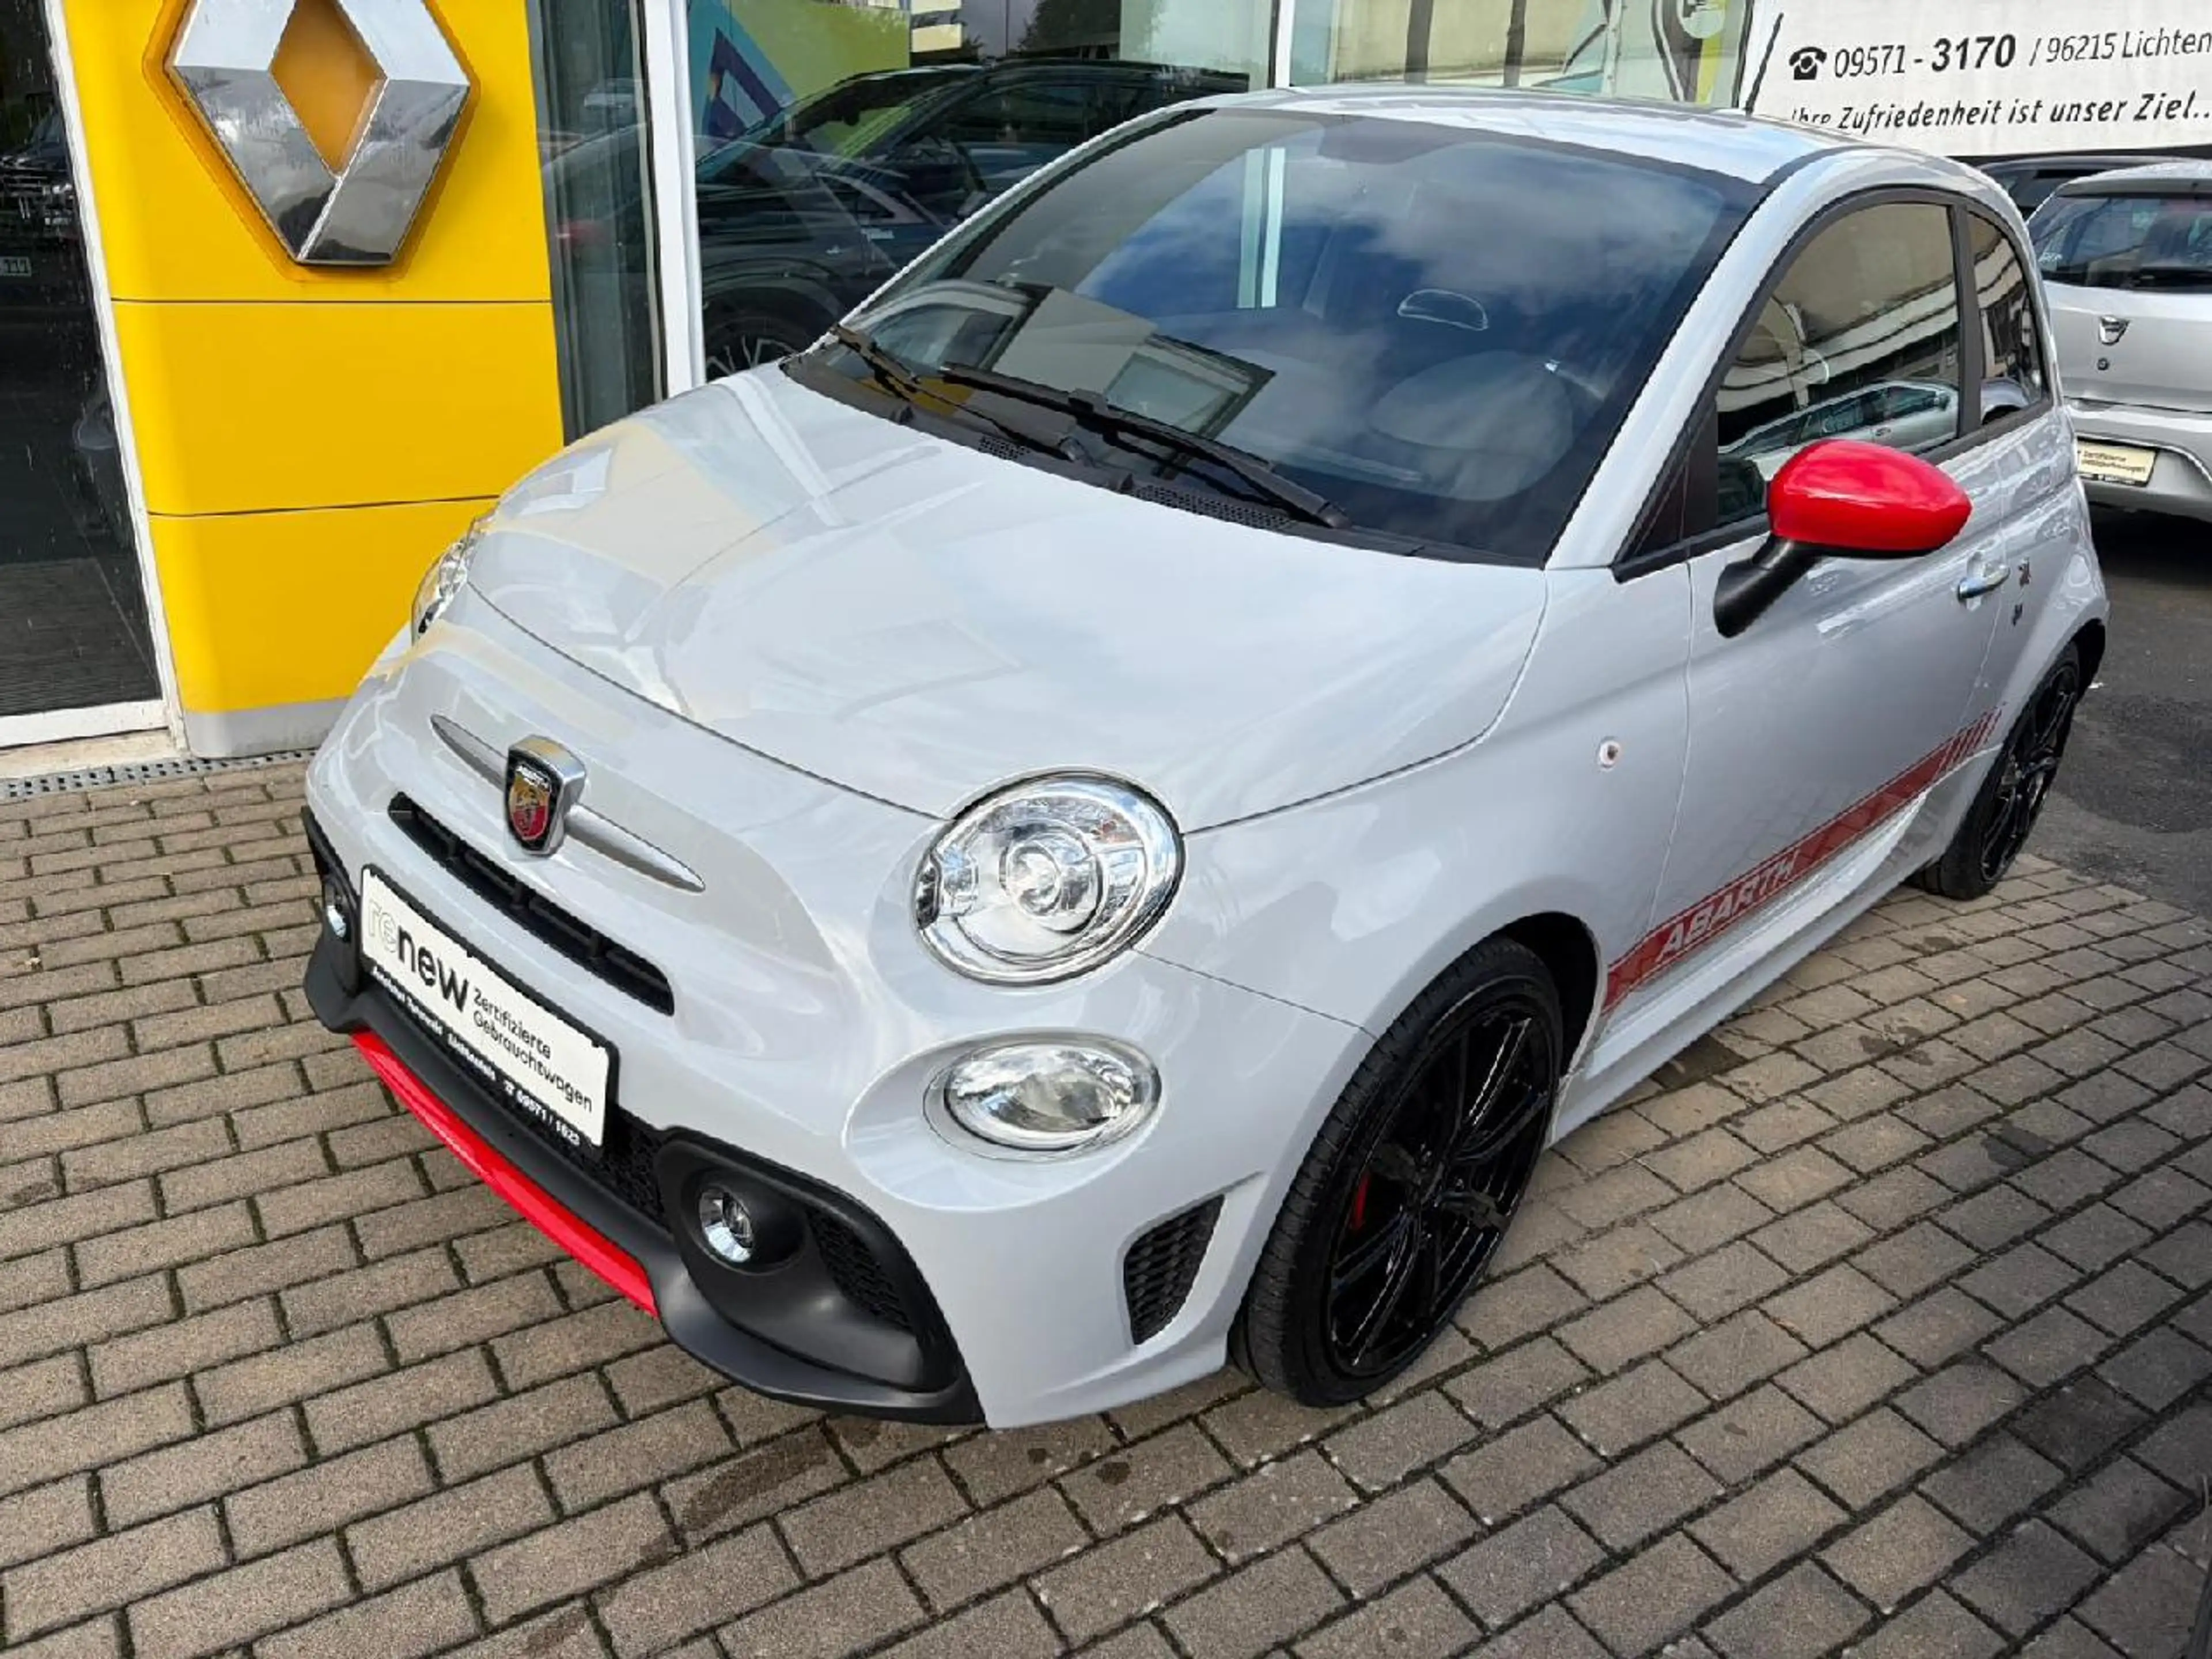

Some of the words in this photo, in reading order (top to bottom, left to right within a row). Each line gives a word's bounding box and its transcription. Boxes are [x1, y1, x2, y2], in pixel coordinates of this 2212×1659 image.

[1834, 46, 1905, 78] 09571
[1931, 33, 2016, 72] 3170
[1838, 100, 2002, 135] Zufriedenheit
[2008, 99, 2043, 124] ist
[2049, 100, 2128, 123] unser
[1654, 848, 1801, 963] ABARTH
[473, 987, 552, 1060] Zertifizierte
[472, 1010, 593, 1113] Gebrauchtwagen
